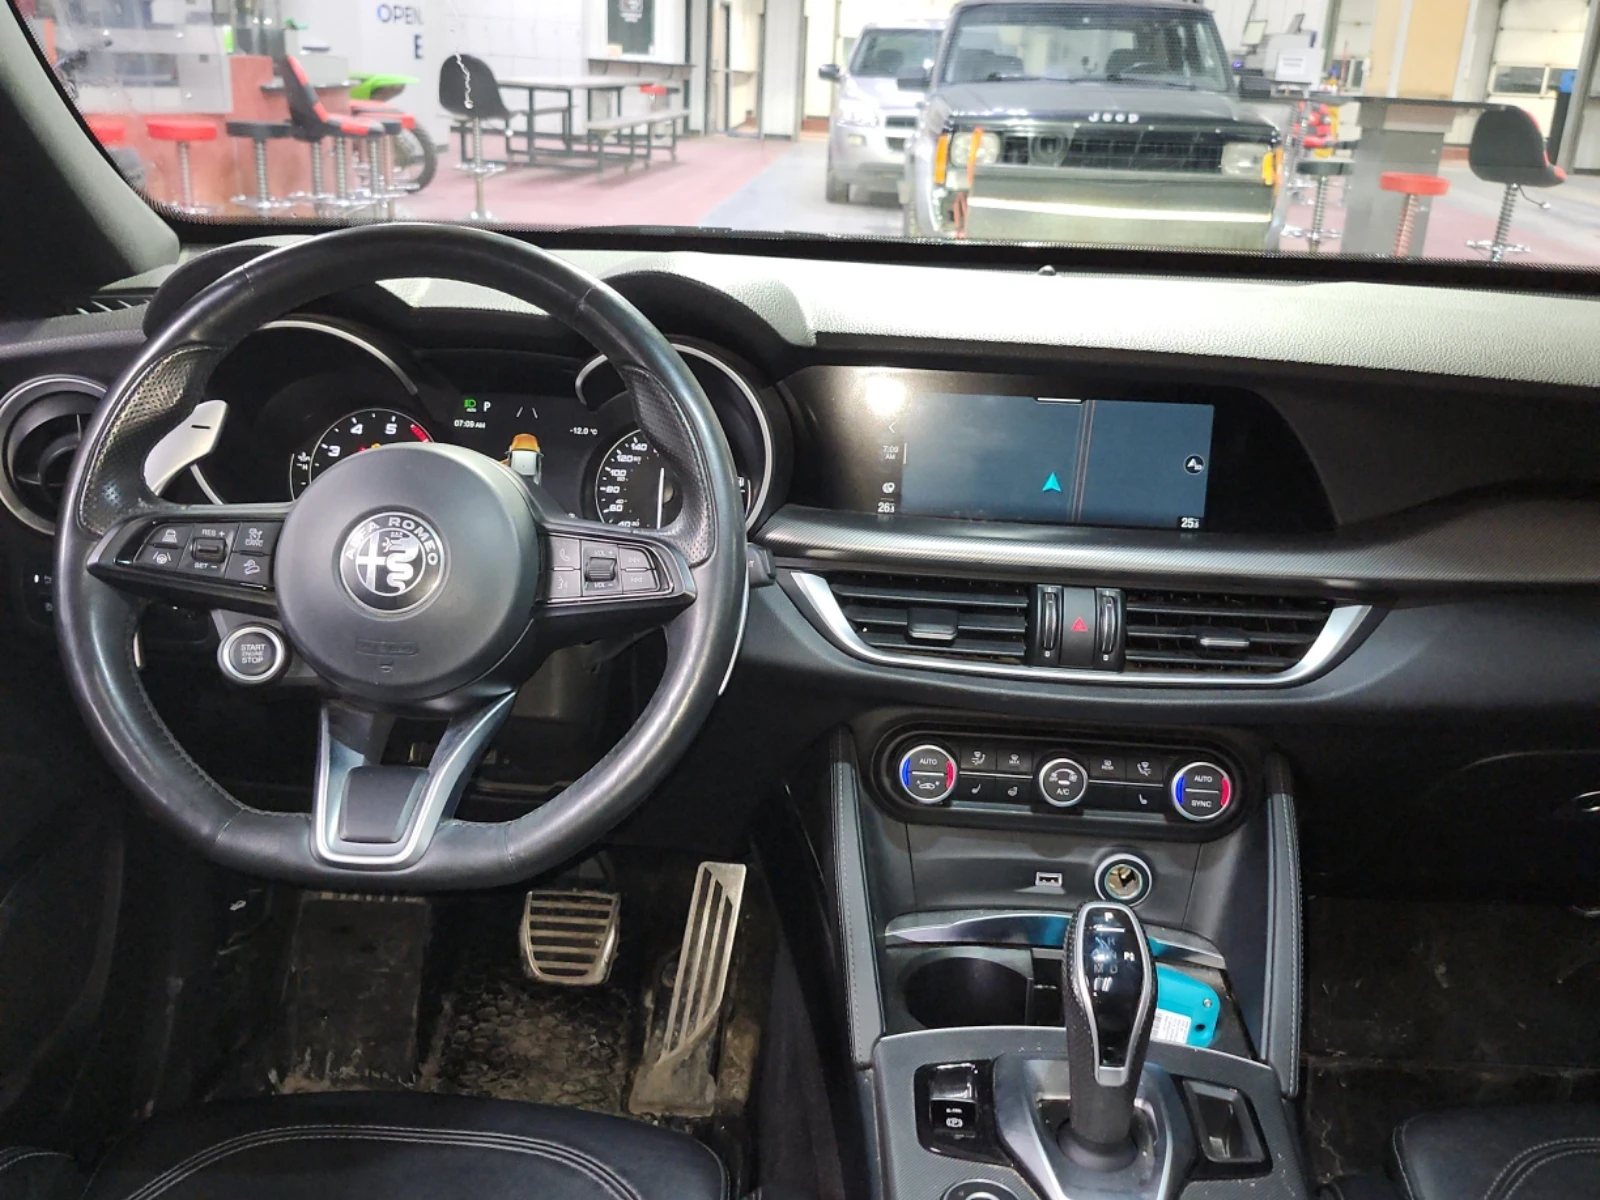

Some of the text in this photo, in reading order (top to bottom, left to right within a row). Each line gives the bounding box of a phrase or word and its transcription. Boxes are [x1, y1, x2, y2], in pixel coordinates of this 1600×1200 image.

[483, 401, 491, 412] P
[385, 423, 397, 434] 5
[454, 419, 486, 429] 07:09 AM
[350, 424, 363, 434] 4
[328, 445, 340, 457] 3
[630, 443, 648, 451] 140
[616, 454, 633, 463] 120
[610, 469, 627, 477] 100
[202, 529, 216, 537] RES
[388, 517, 438, 566] ROMEO
[1194, 775, 1213, 783] AUTO
[1056, 788, 1070, 796] A/C
[1191, 799, 1212, 808] SYNC
[1104, 912, 1114, 922] P
